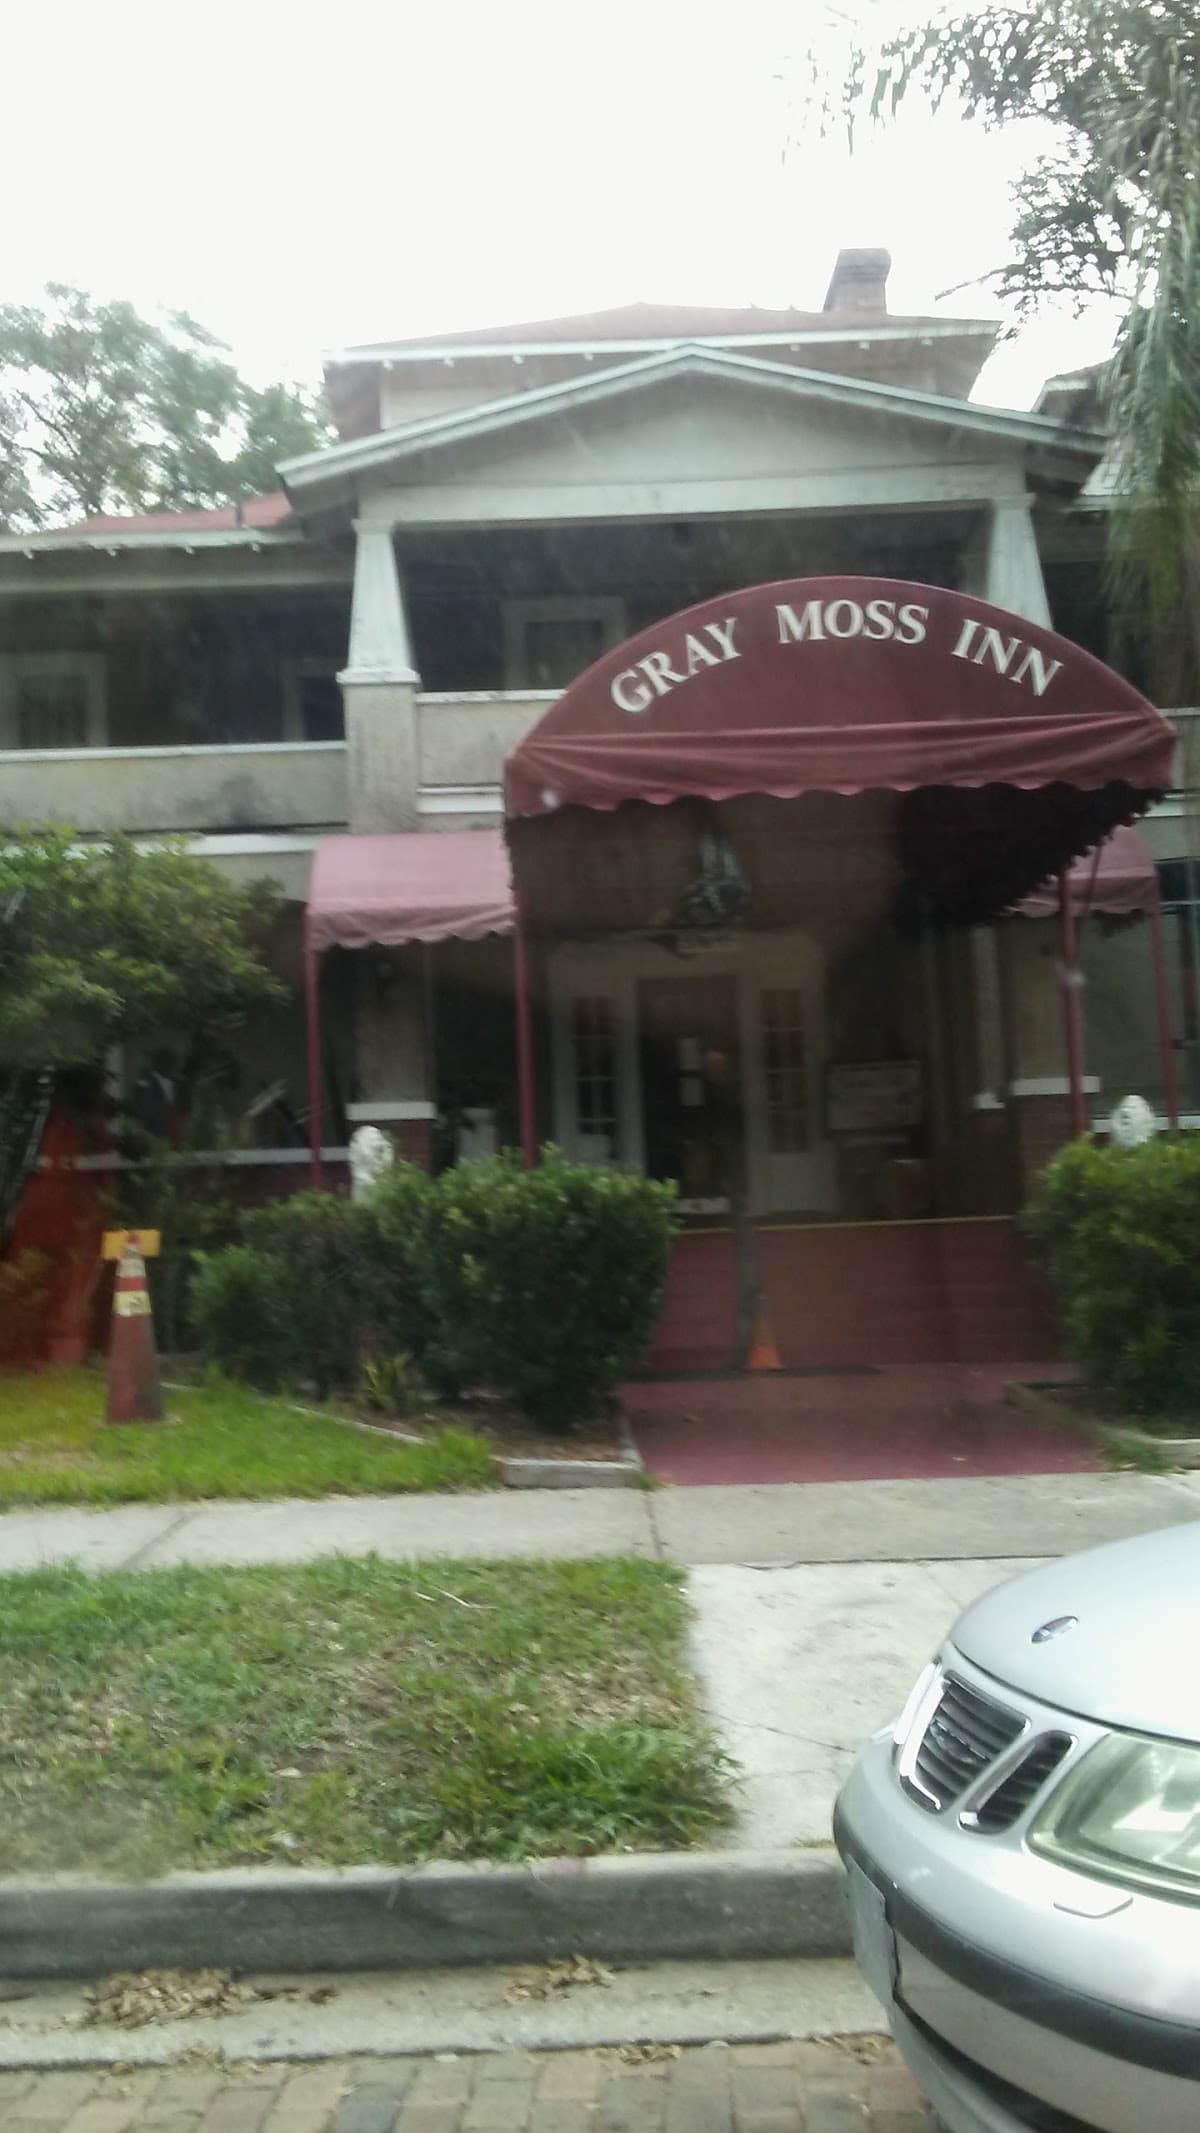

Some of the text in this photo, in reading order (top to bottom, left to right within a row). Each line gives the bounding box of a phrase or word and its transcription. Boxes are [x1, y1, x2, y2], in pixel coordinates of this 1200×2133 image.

[610, 599, 1064, 713] GRAY MOSS INN
